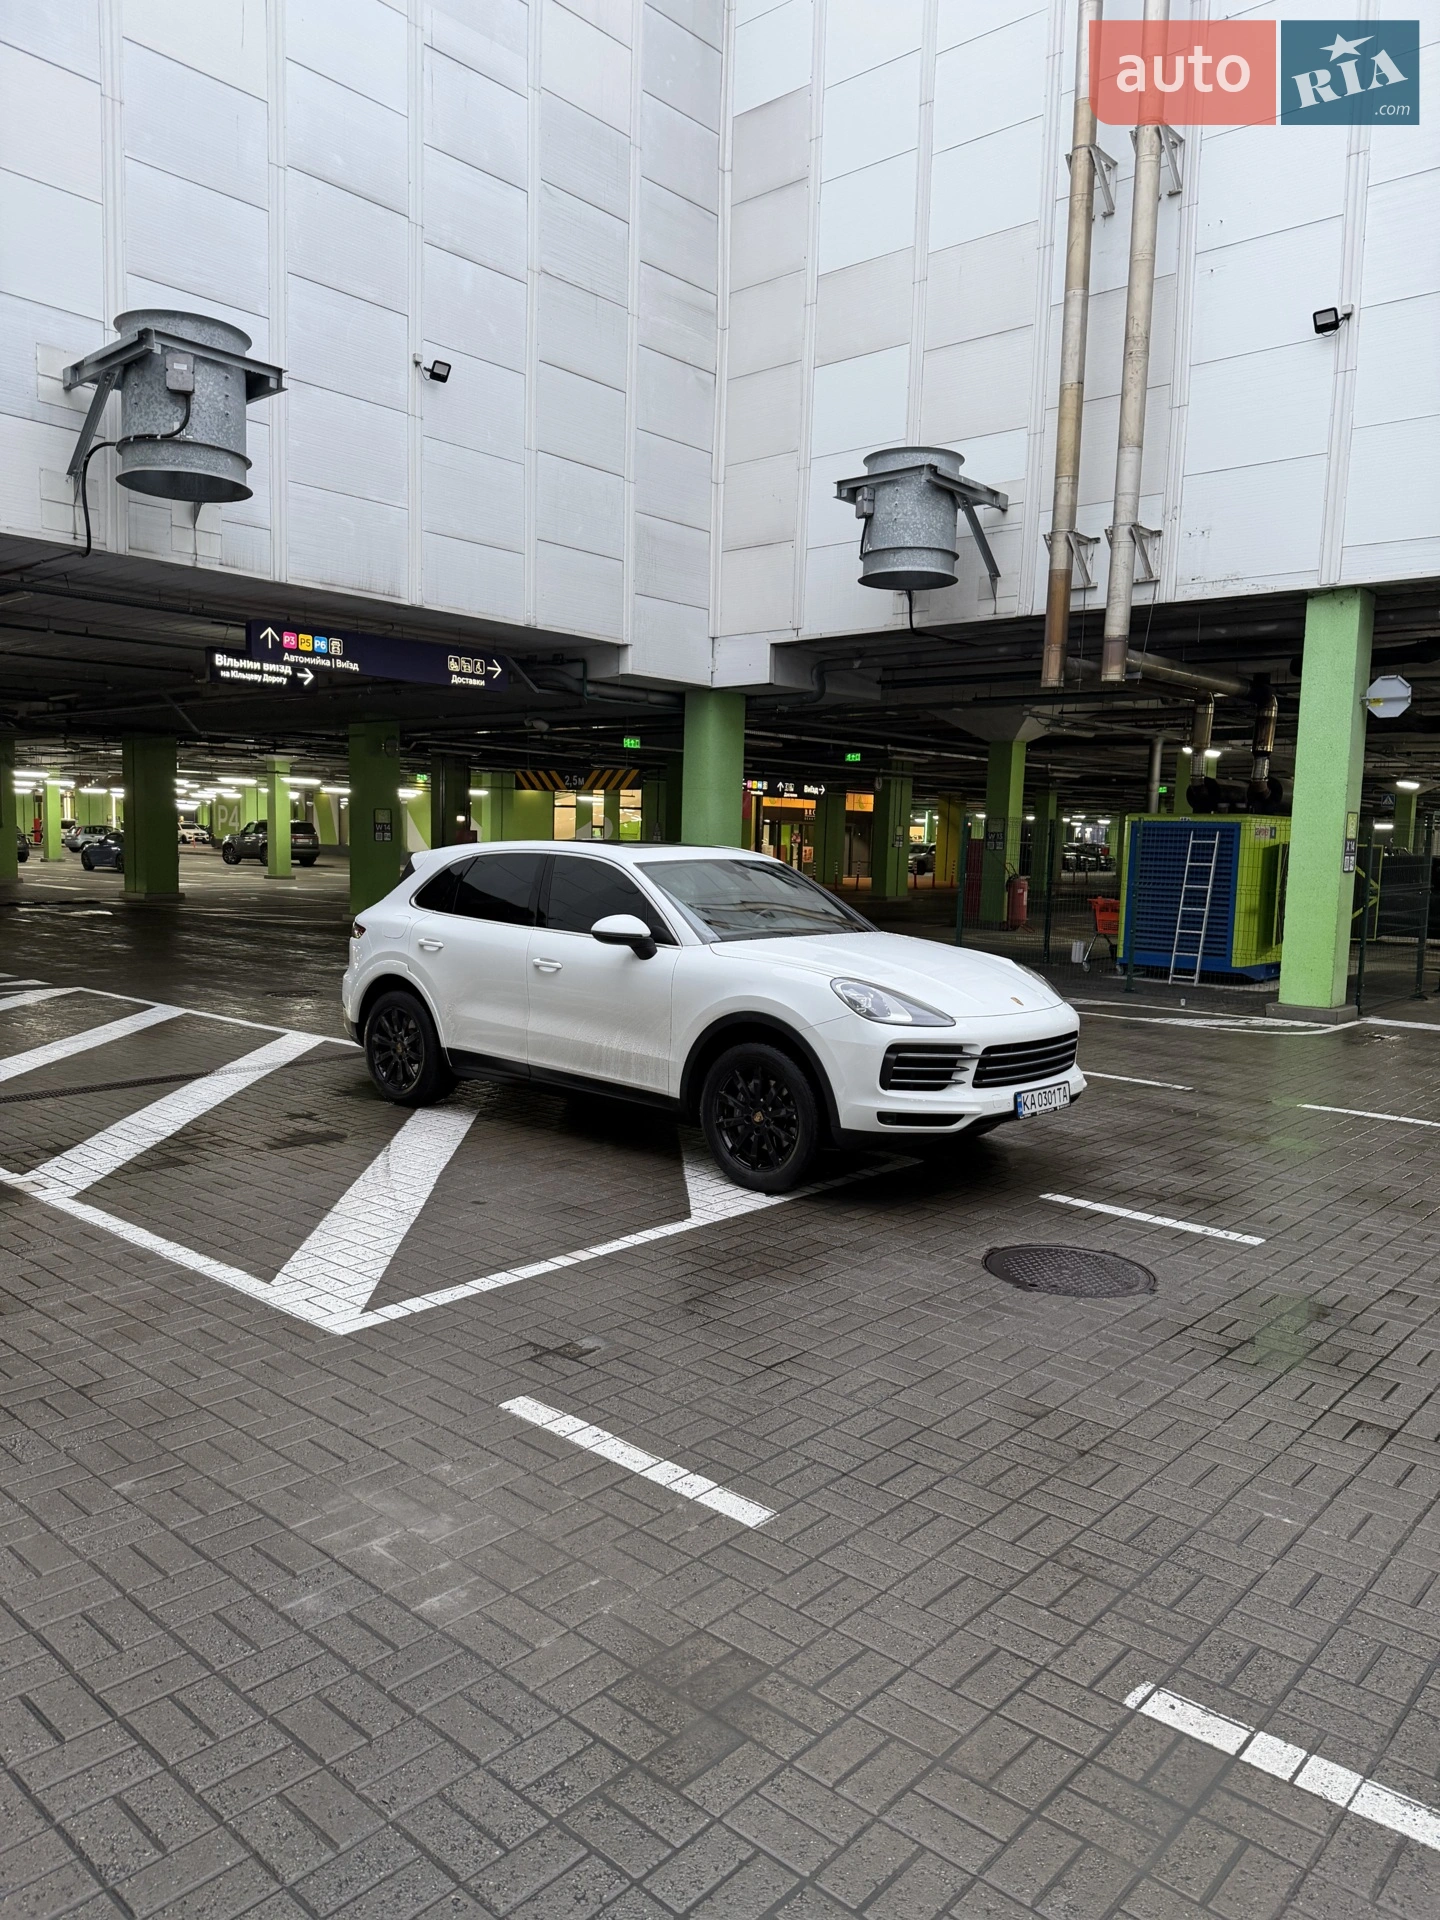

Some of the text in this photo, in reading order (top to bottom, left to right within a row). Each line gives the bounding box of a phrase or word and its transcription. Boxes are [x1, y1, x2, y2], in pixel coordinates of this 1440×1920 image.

[284, 634, 327, 650] P3 P5 P6
[283, 652, 331, 667] Автомийка
[336, 659, 360, 671] Виїзд
[230, 670, 262, 682] Кільцеву
[262, 674, 288, 685] Дорогу
[451, 674, 486, 686] Доставки
[217, 804, 240, 831] P4
